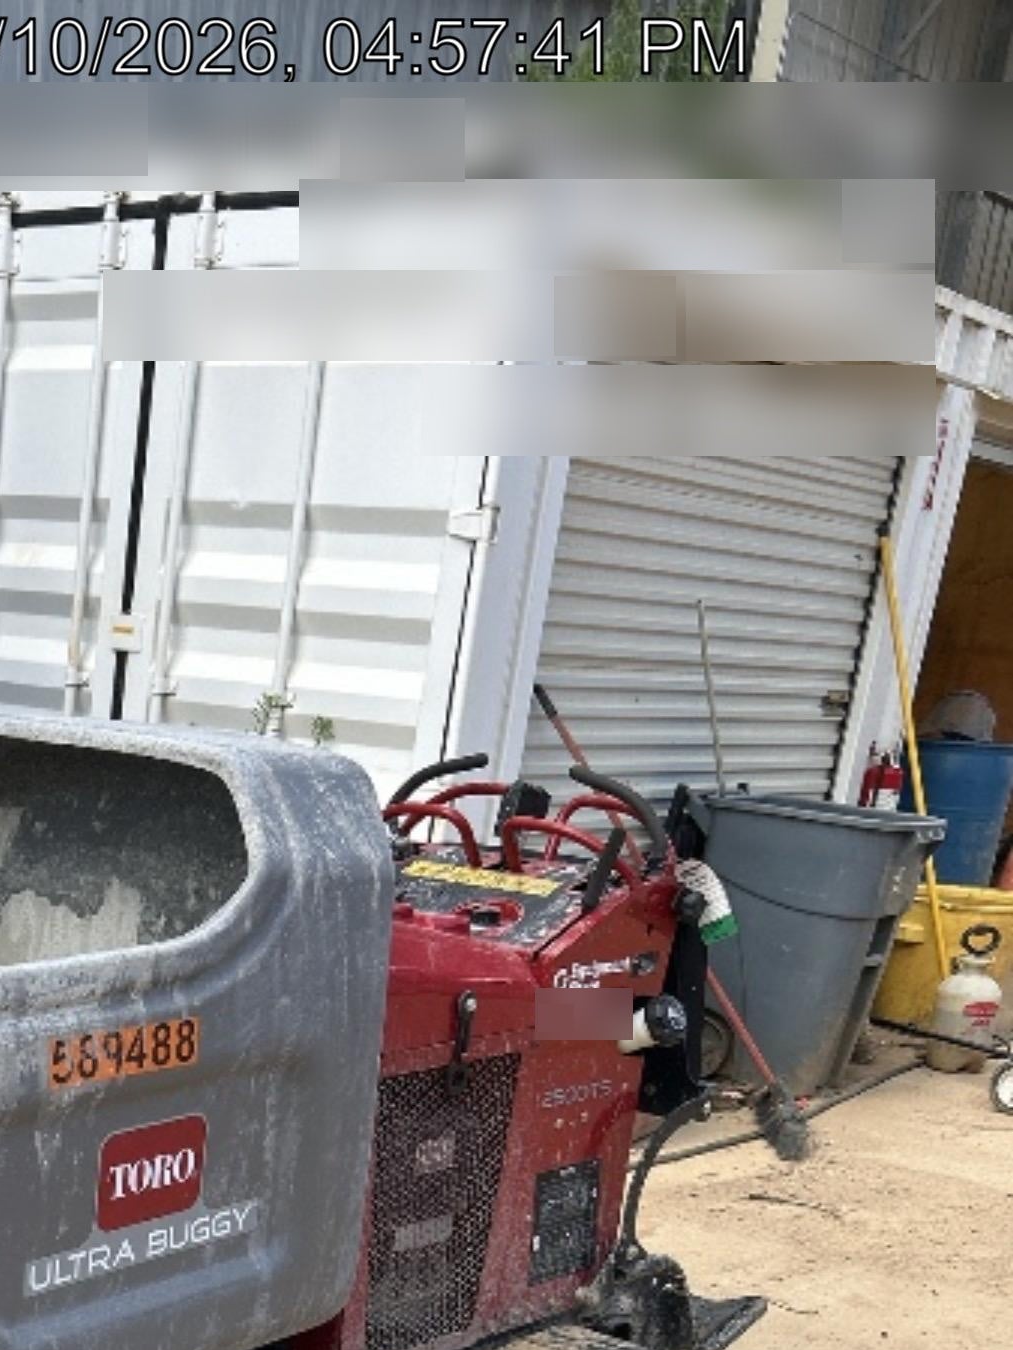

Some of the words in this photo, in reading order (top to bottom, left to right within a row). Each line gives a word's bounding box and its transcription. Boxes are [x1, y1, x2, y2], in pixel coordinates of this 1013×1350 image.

[108, 1148, 195, 1200] TORO
[29, 1239, 136, 1292] ULTRA
[146, 1201, 259, 1256] BUGGY
